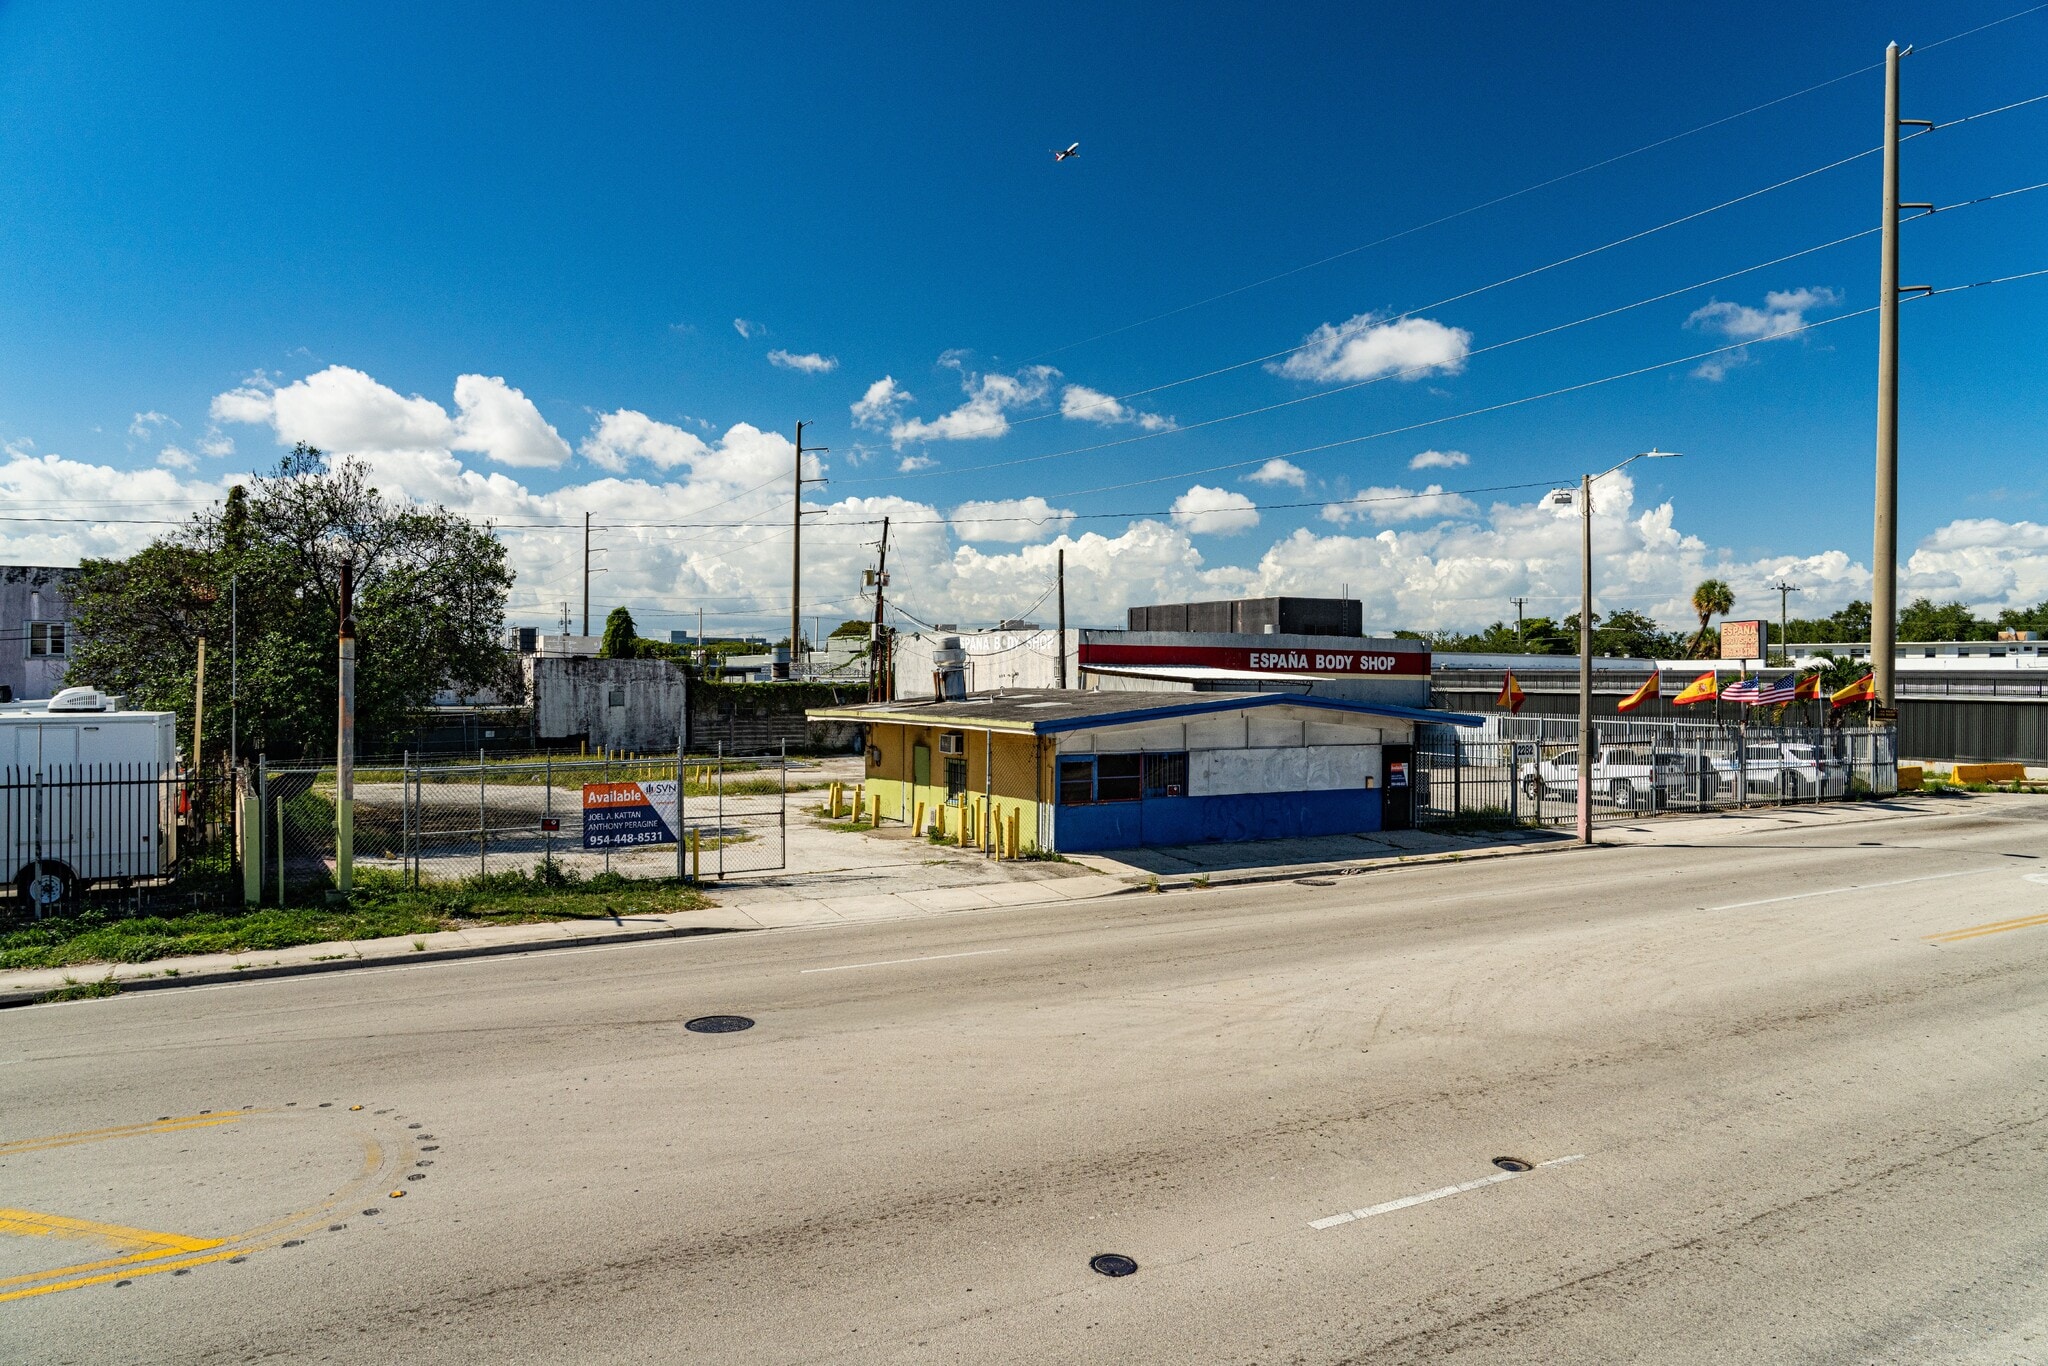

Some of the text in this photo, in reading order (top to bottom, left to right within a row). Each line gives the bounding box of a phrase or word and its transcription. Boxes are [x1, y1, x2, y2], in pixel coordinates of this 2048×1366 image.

[1723, 624, 1757, 636] ESPAÑA
[1250, 651, 1396, 670] ESPAÑA BODY SHOP
[1518, 745, 1533, 755] 2282
[656, 784, 677, 793] SVN
[588, 789, 641, 803] Available
[588, 811, 641, 821] JOEL A. KATTAN
[588, 820, 658, 831] ANTHONY PERAGINE
[590, 832, 663, 846] 954-448-8531
